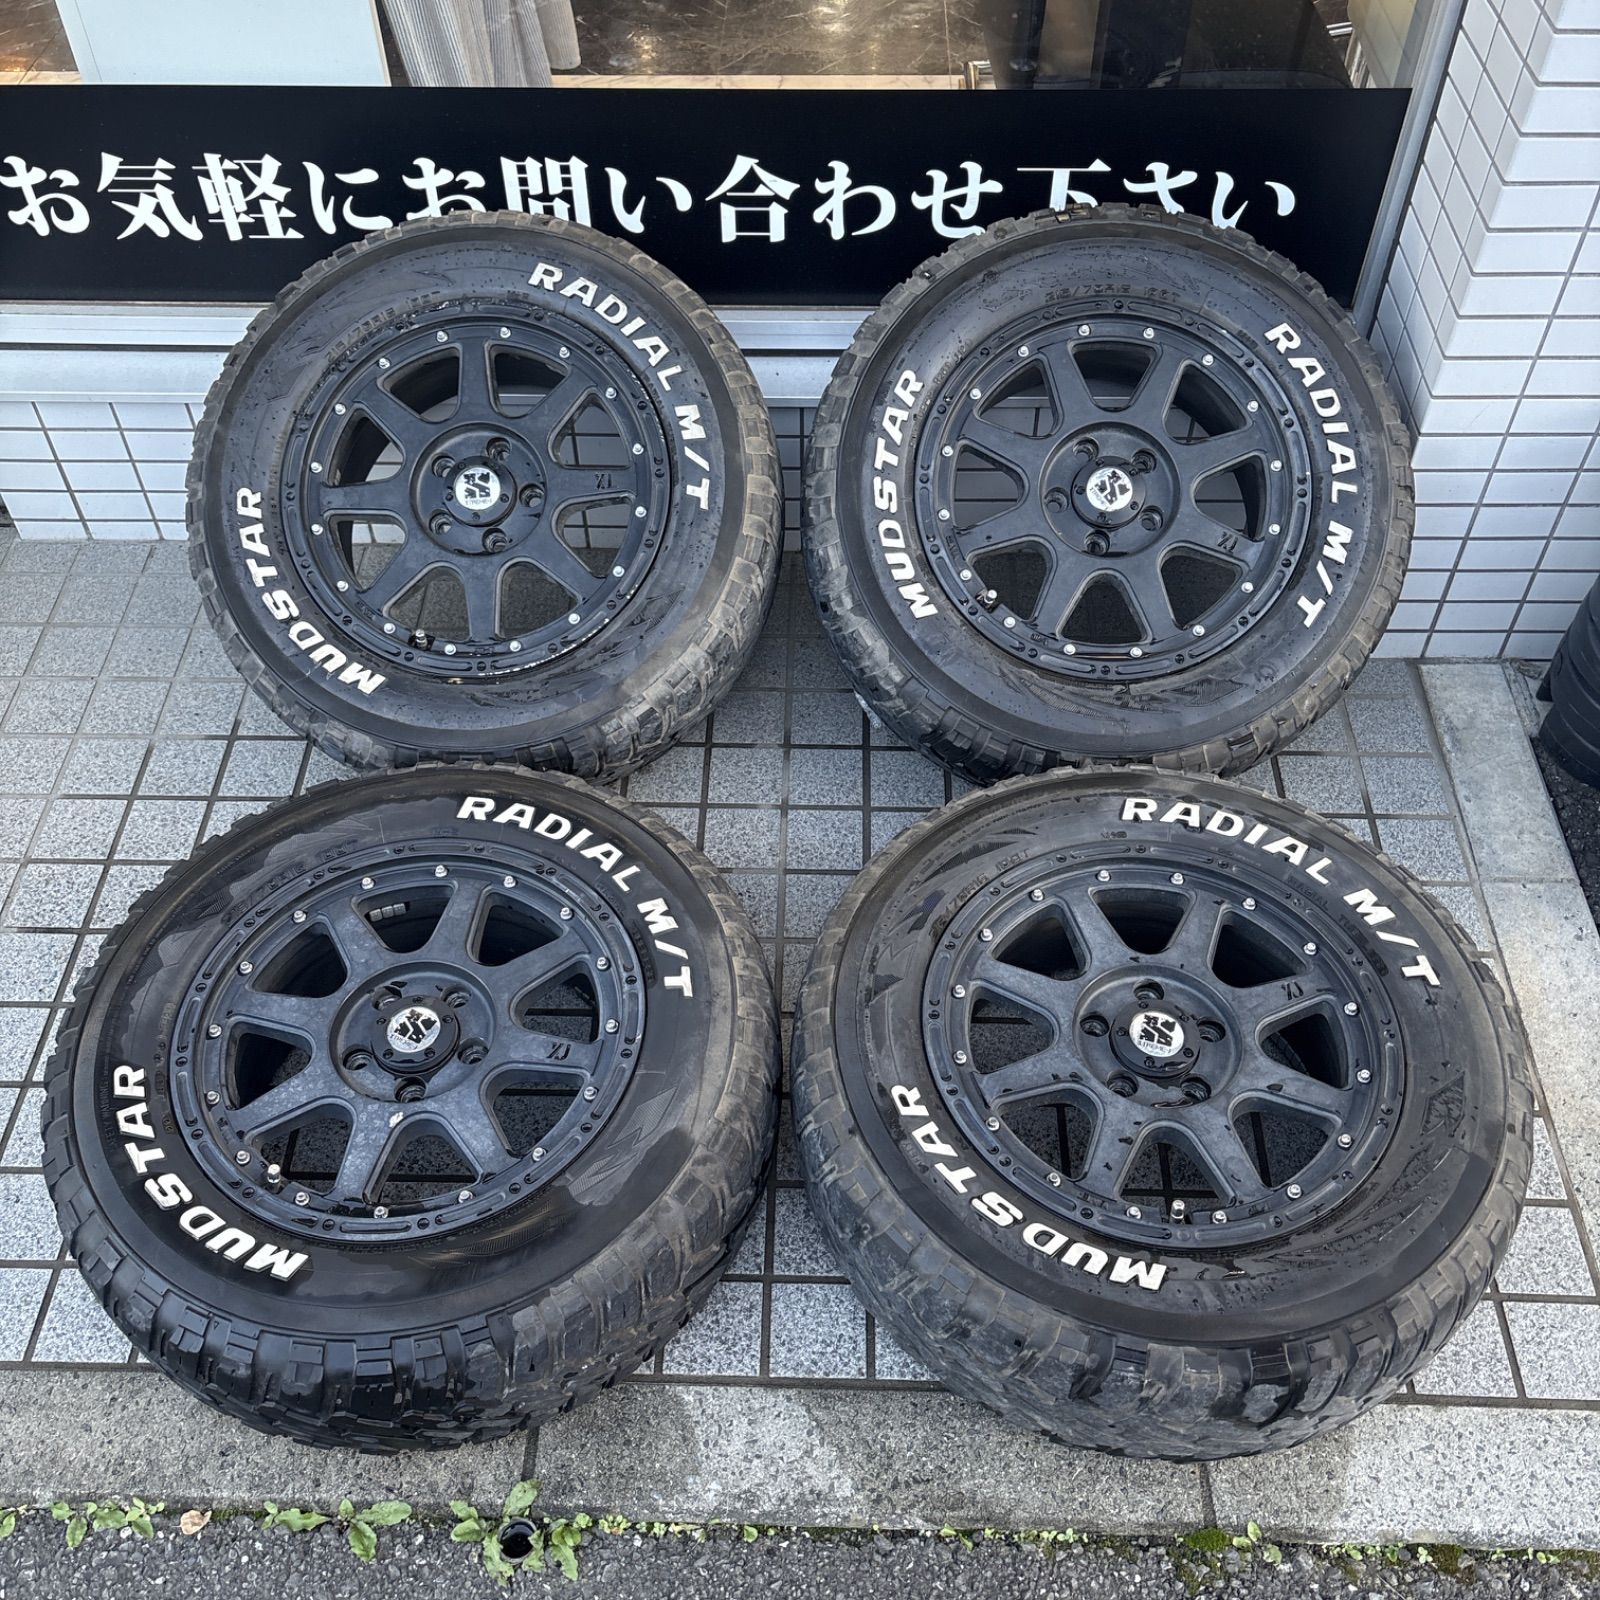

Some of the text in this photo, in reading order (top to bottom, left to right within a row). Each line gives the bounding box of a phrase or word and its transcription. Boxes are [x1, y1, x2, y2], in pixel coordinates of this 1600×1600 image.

[528, 263, 711, 511] RADIAL M/T
[1265, 323, 1357, 628] RADIAL M/T
[236, 487, 386, 695] MUDSTAR
[873, 369, 937, 621] MUDSTAR
[456, 796, 643, 891] RADIAL
[636, 897, 693, 998] M/T
[1122, 797, 1331, 885] RADIAL
[1343, 888, 1440, 986] M/T
[113, 1065, 310, 1279] MUDSTAR
[890, 1084, 1167, 1290] MUDSTAR
